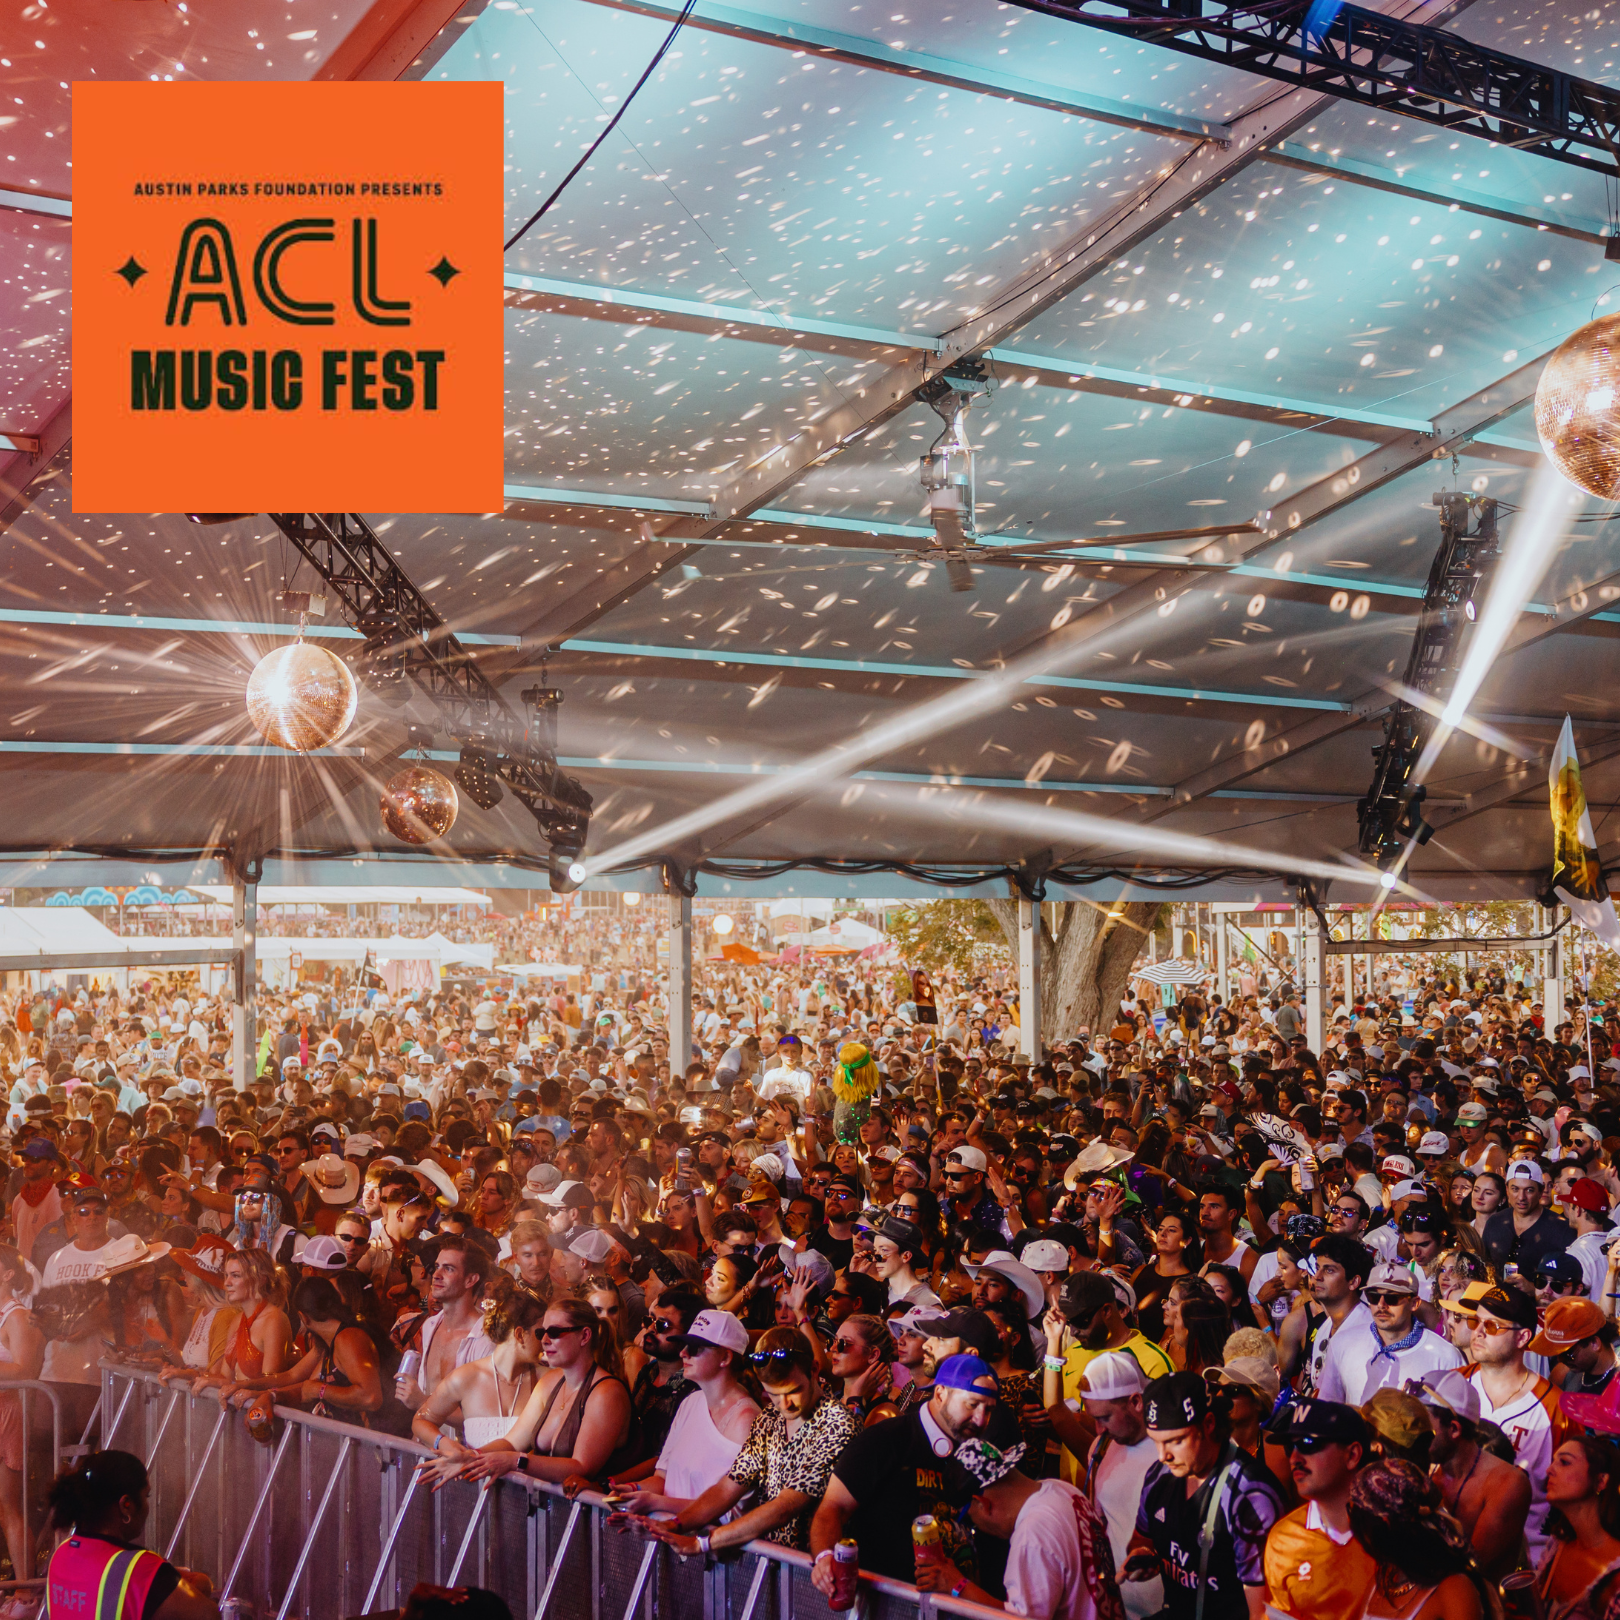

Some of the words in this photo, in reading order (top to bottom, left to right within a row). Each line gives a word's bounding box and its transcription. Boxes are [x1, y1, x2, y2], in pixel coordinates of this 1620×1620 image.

[1378, 1267, 1393, 1279] W
[1292, 1404, 1312, 1424] W
[1512, 1425, 1529, 1452] T
[1170, 1540, 1189, 1567] Fly
[1162, 1558, 1219, 1591] mirats
[52, 1583, 87, 1612] STAFF
